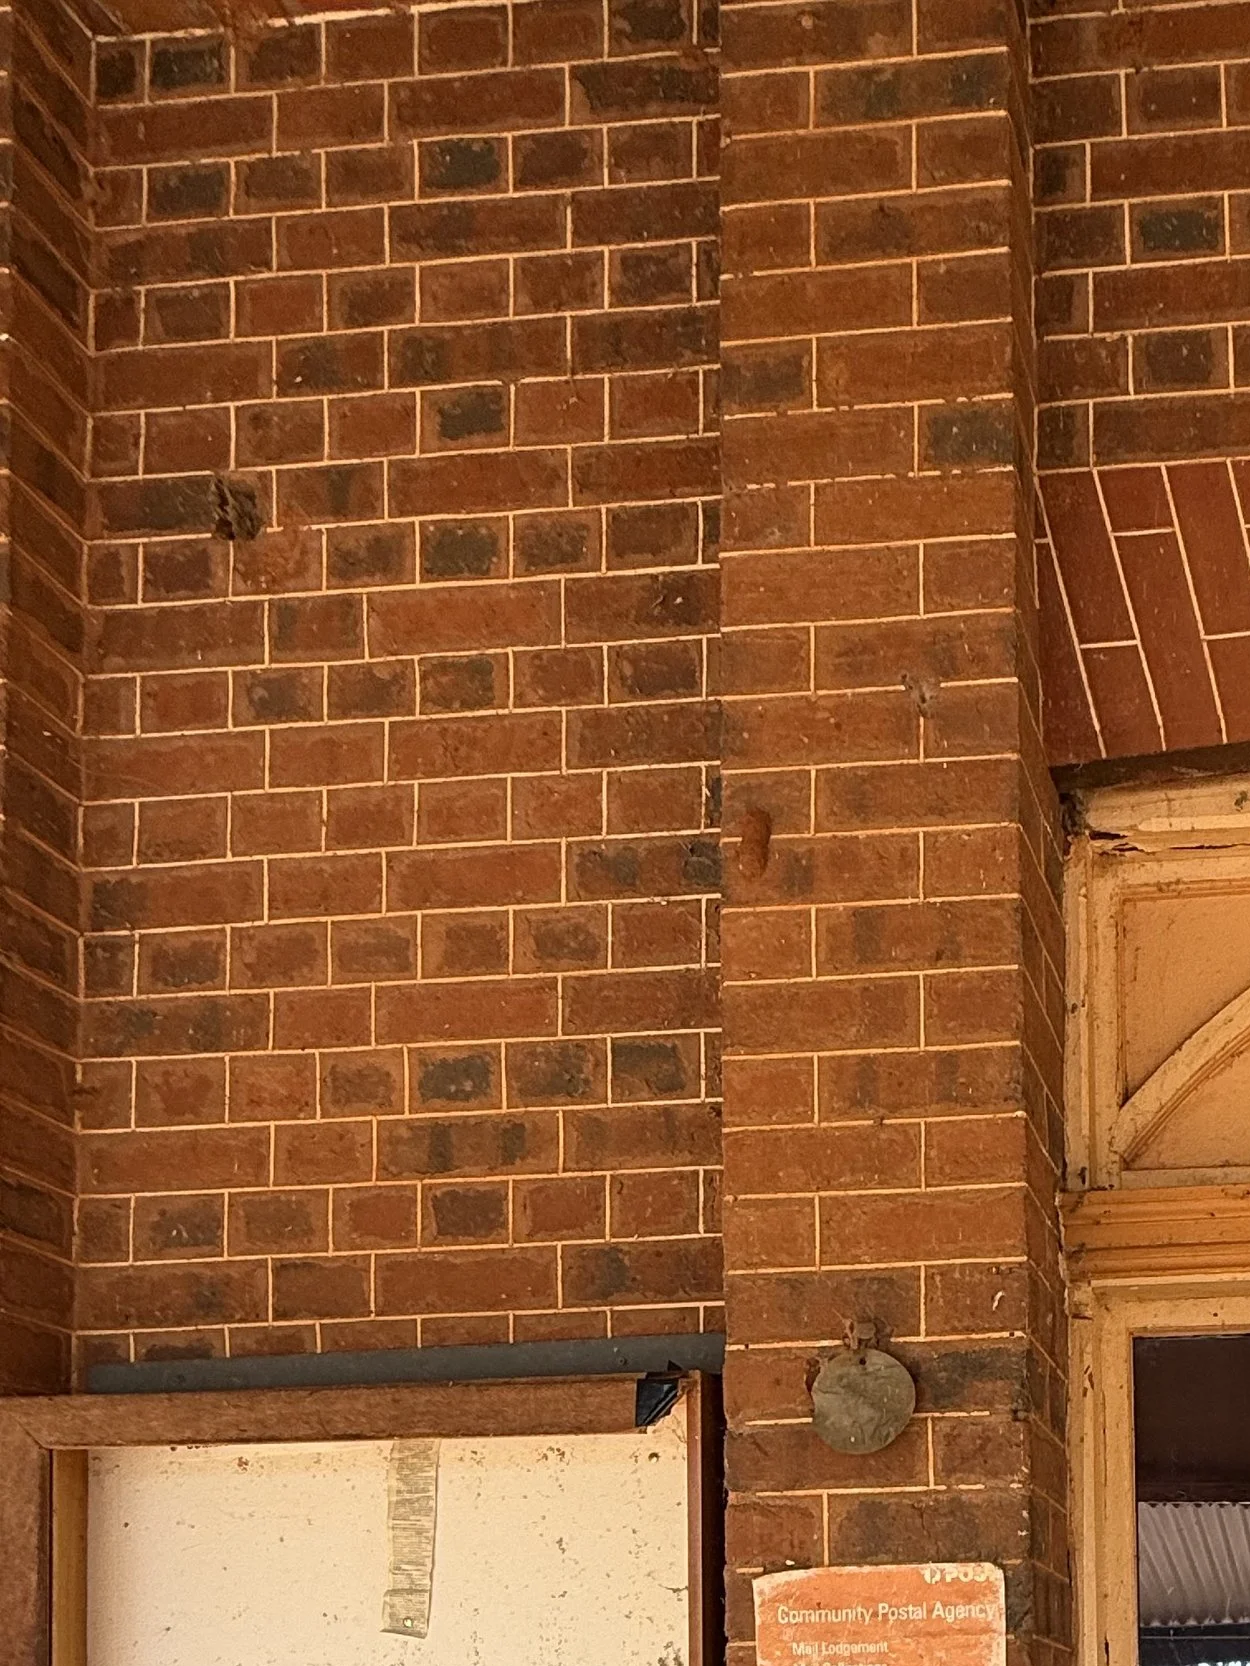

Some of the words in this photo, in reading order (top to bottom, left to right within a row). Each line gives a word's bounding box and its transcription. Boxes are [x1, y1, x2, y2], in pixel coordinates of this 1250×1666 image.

[777, 1604, 873, 1625] Community
[878, 1602, 927, 1623] Postal
[932, 1601, 995, 1623] Agency
[792, 1641, 818, 1656] Mail
[822, 1641, 889, 1657] Lodgement
